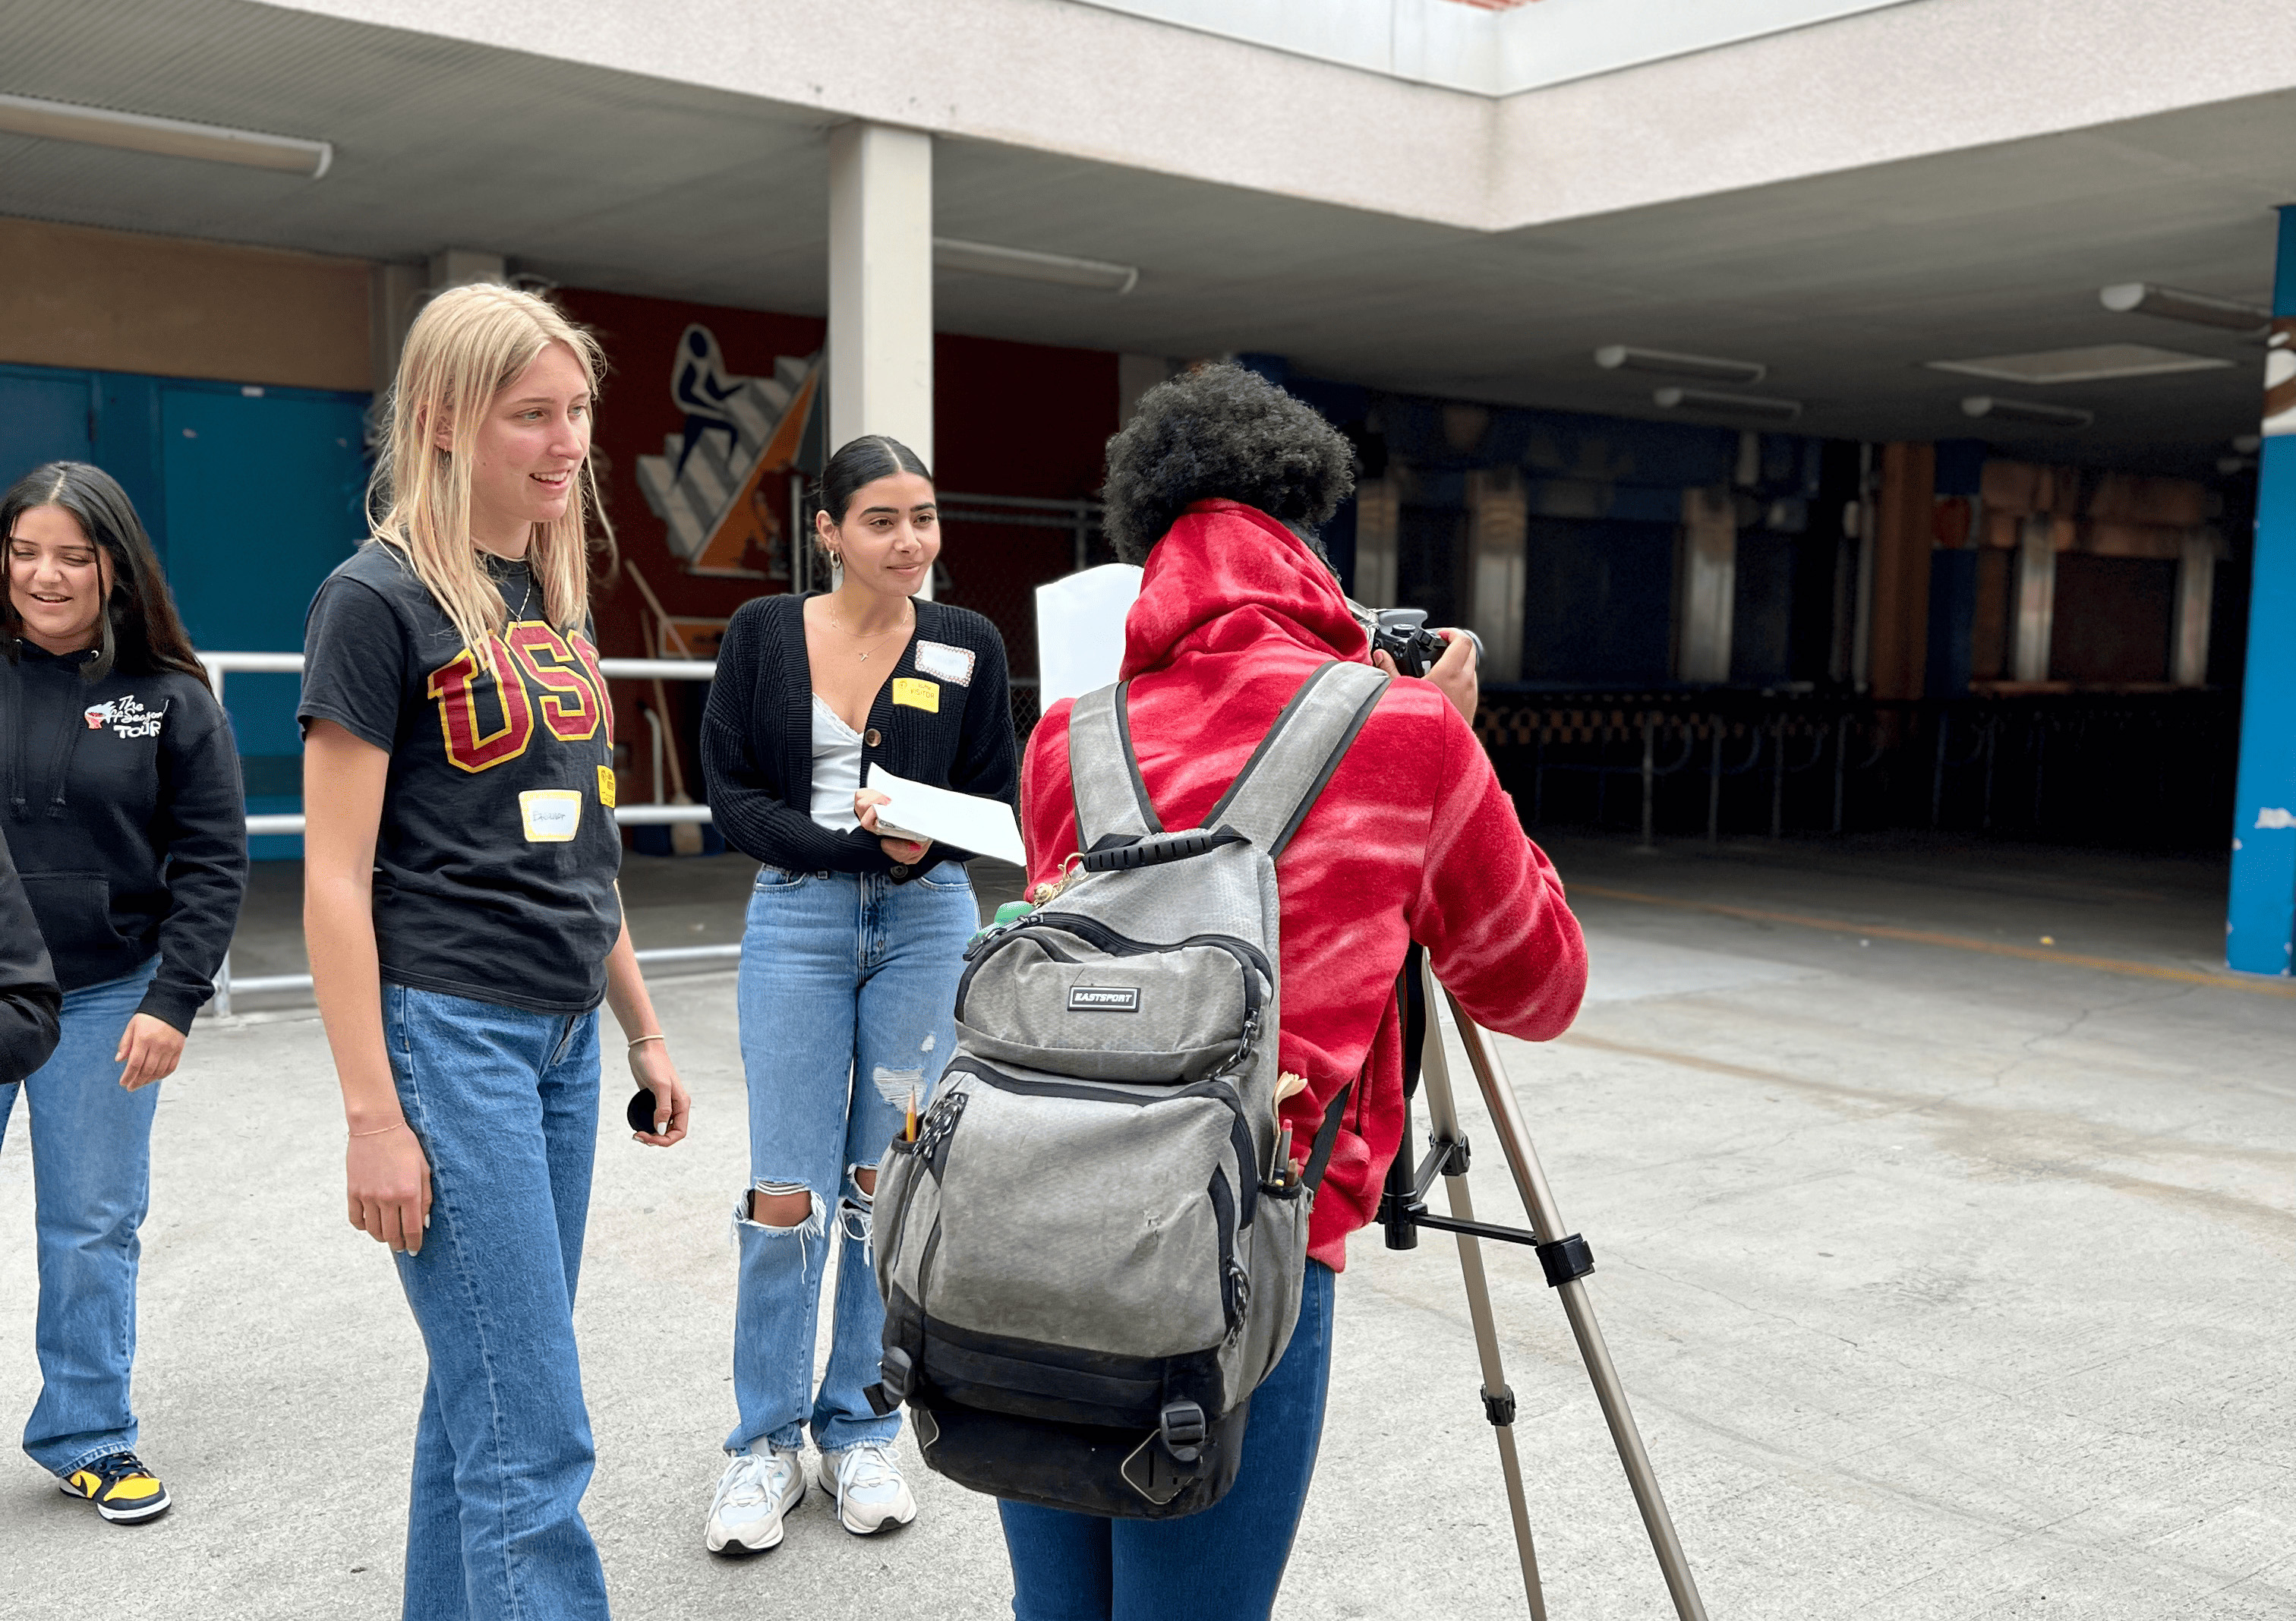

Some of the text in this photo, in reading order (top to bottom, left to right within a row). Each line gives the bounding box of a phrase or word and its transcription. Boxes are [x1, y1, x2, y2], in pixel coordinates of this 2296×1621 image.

[118, 695, 144, 712] The
[113, 721, 162, 739] TOUR
[1074, 992, 1133, 1003] EASTSPORT
